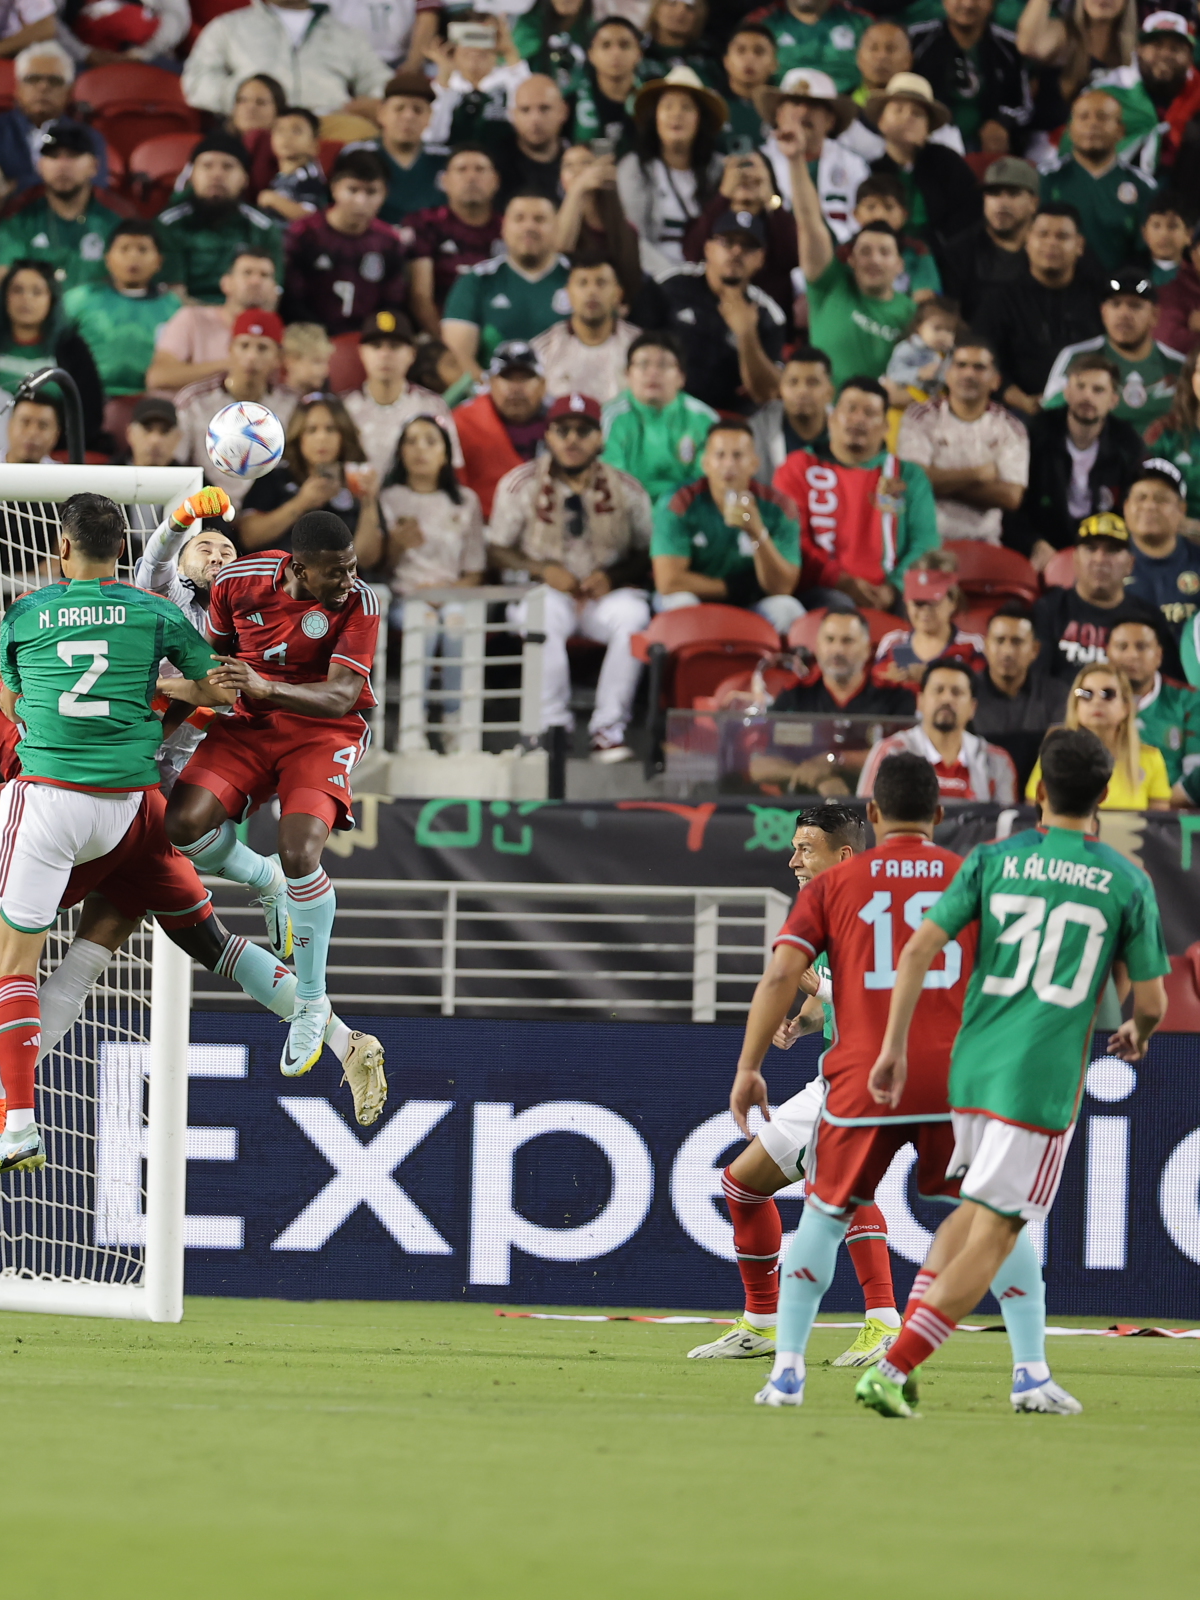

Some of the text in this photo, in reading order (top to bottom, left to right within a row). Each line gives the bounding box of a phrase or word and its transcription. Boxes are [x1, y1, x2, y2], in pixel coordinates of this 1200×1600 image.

[39, 605, 126, 629] N. ARAUJO
[263, 641, 288, 666] 4
[57, 640, 111, 717] 2
[332, 744, 357, 775] 4
[870, 859, 944, 878] FABRA
[1002, 853, 1113, 894] K. ÁLVAREZ
[981, 893, 1108, 1009] 30
[93, 1041, 1200, 1285] Expei
